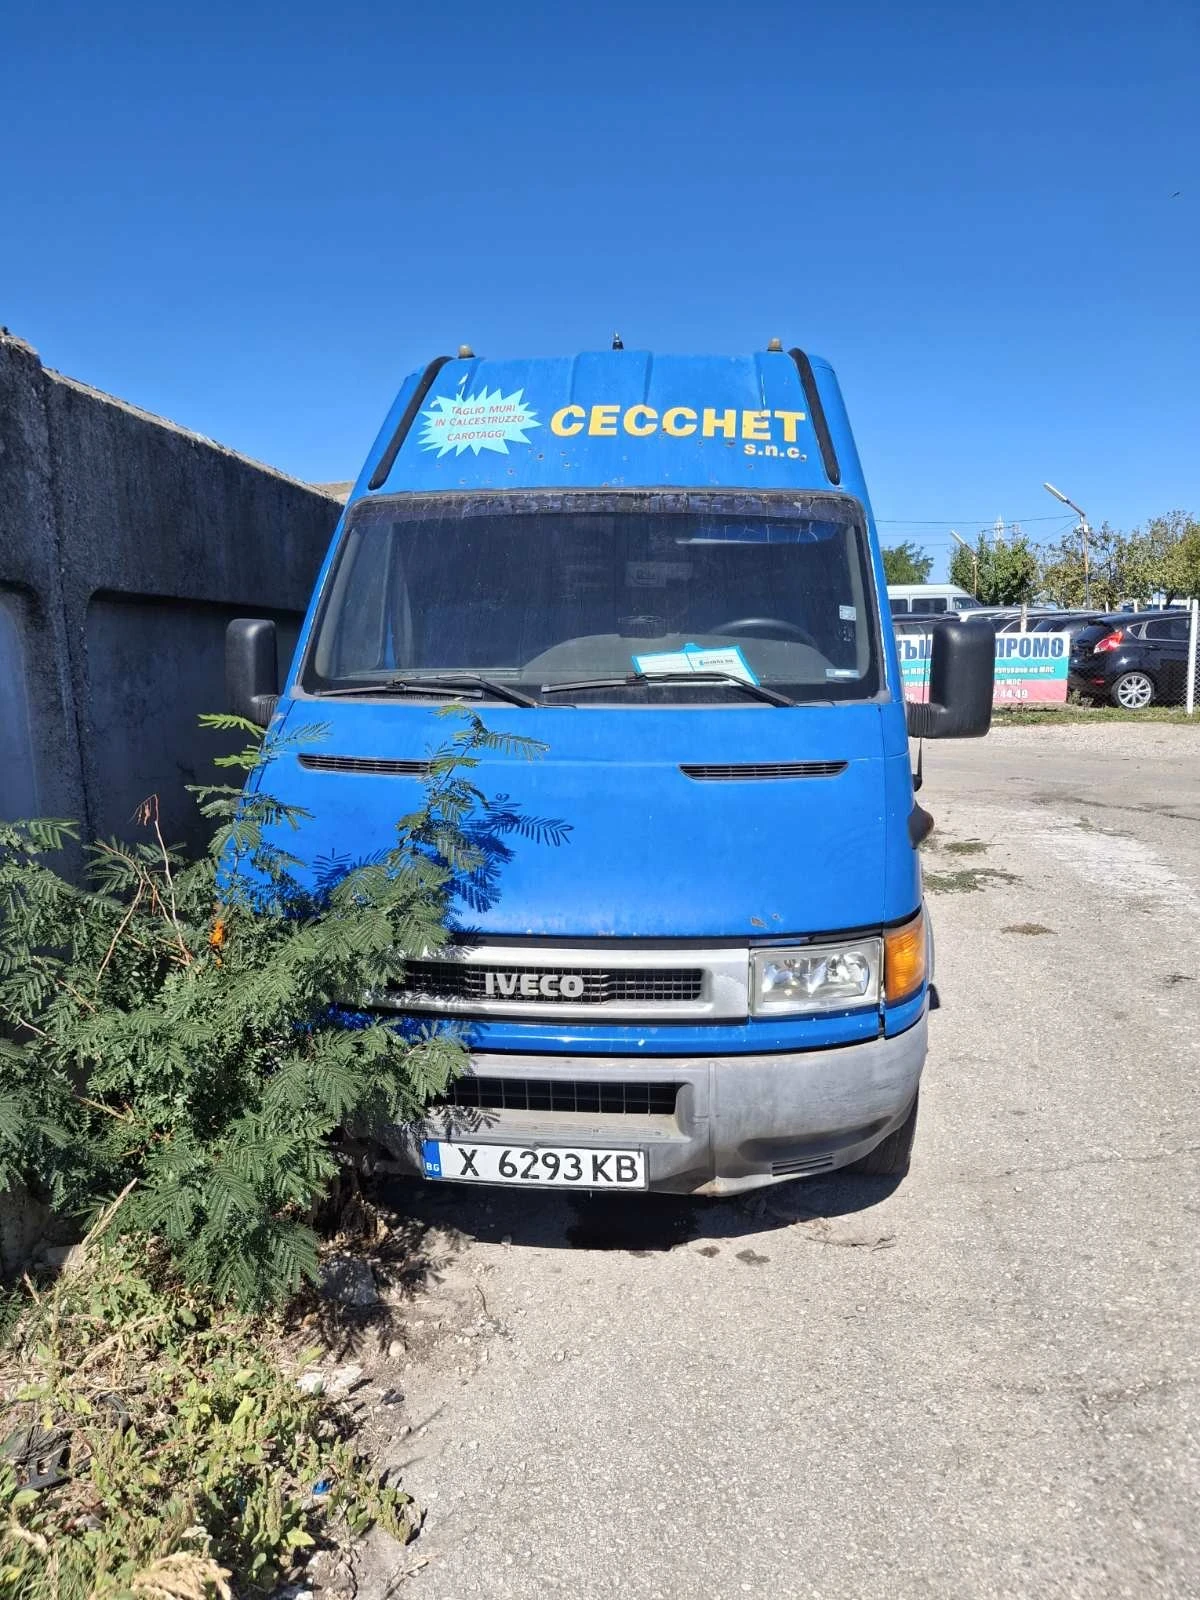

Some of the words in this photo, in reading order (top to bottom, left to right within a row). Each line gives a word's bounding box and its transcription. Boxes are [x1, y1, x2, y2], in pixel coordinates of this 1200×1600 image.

[451, 406, 486, 416] TAGLIO
[489, 404, 516, 414] MURI
[434, 418, 446, 427] IN
[449, 415, 525, 426] CALCESTRUZZO
[550, 404, 806, 442] CECCHET
[447, 429, 506, 442] CAROTAGGI
[743, 444, 808, 462] s.n.c.
[484, 972, 585, 998] IVECO
[425, 1161, 440, 1172] BG
